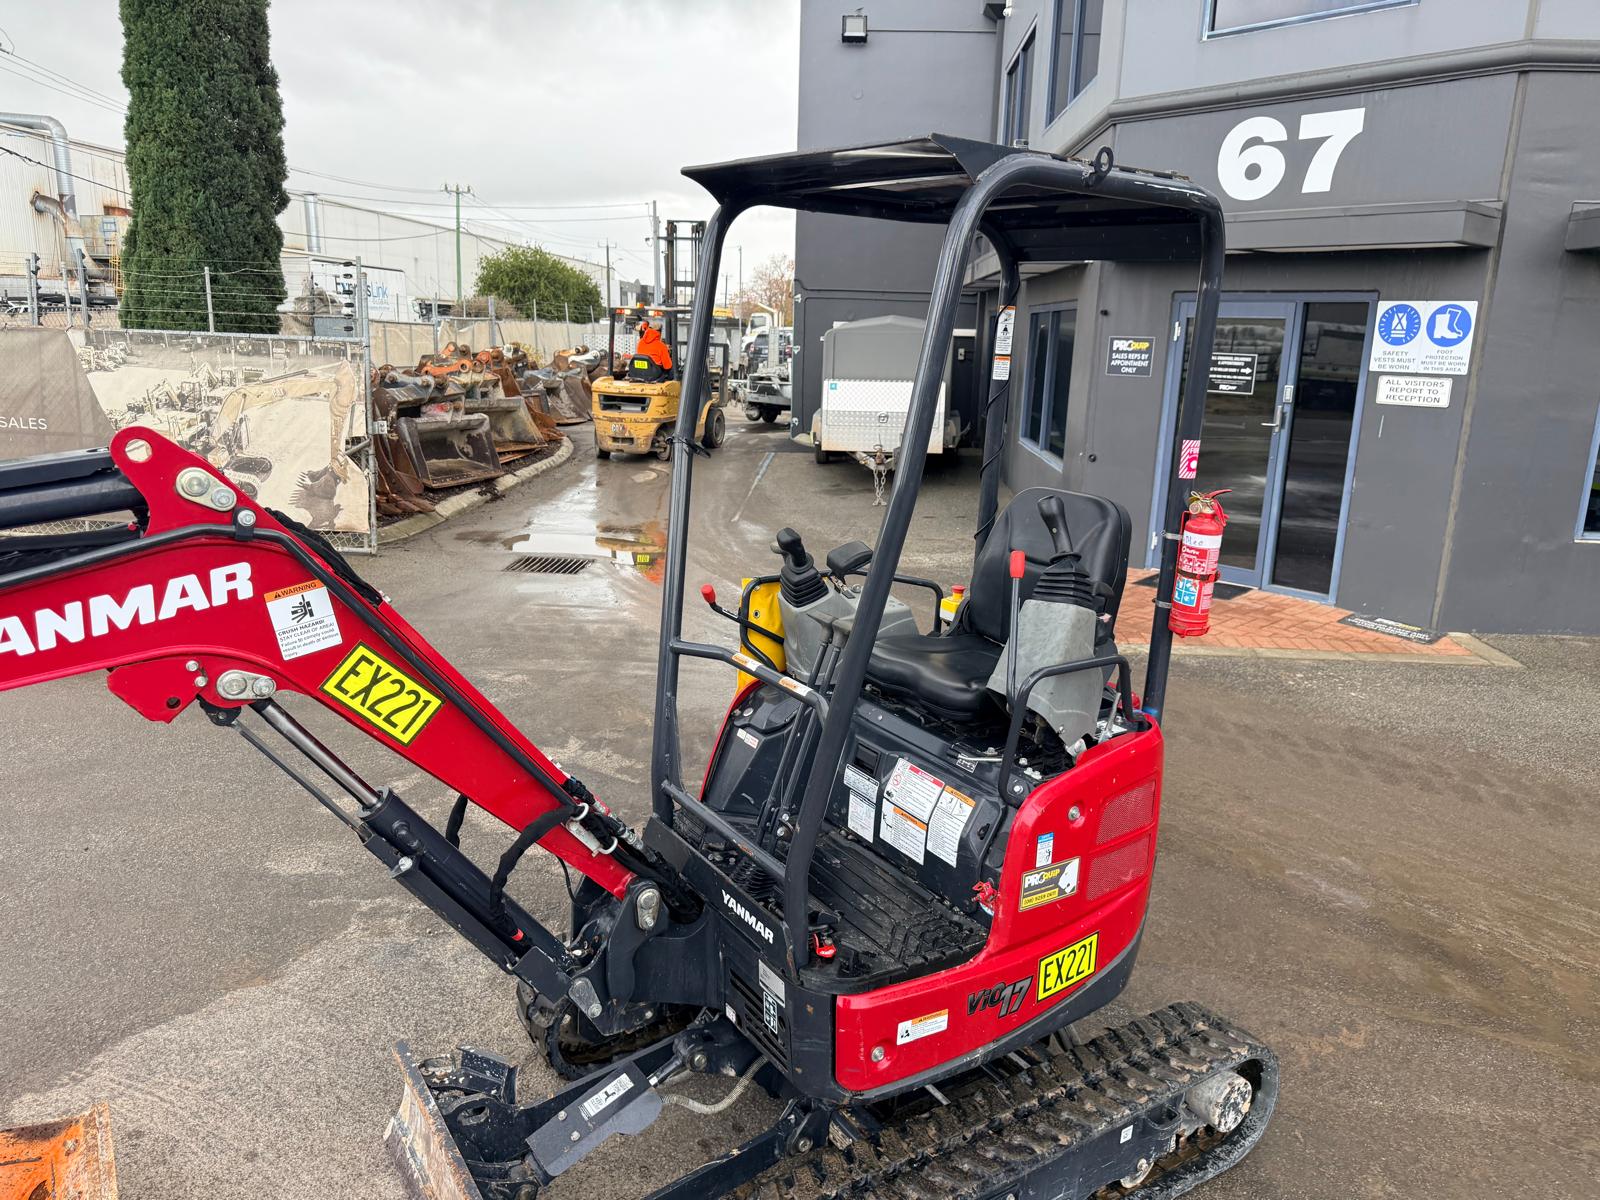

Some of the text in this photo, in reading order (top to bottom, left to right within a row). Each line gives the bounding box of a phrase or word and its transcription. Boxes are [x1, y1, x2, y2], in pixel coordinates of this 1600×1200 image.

[1217, 107, 1366, 200] 67
[1388, 386, 1424, 394] REPORT
[1404, 380, 1445, 388] VISITORS
[1385, 394, 1441, 403] RECEPTION
[0, 416, 48, 430] SALES
[280, 582, 317, 595] WARNING
[278, 627, 299, 637] CRUSH
[279, 635, 293, 643] STAY
[293, 629, 311, 638] CLEAR
[333, 654, 433, 735] EX221
[722, 889, 774, 944] YANMAR
[1042, 939, 1094, 993] EX221
